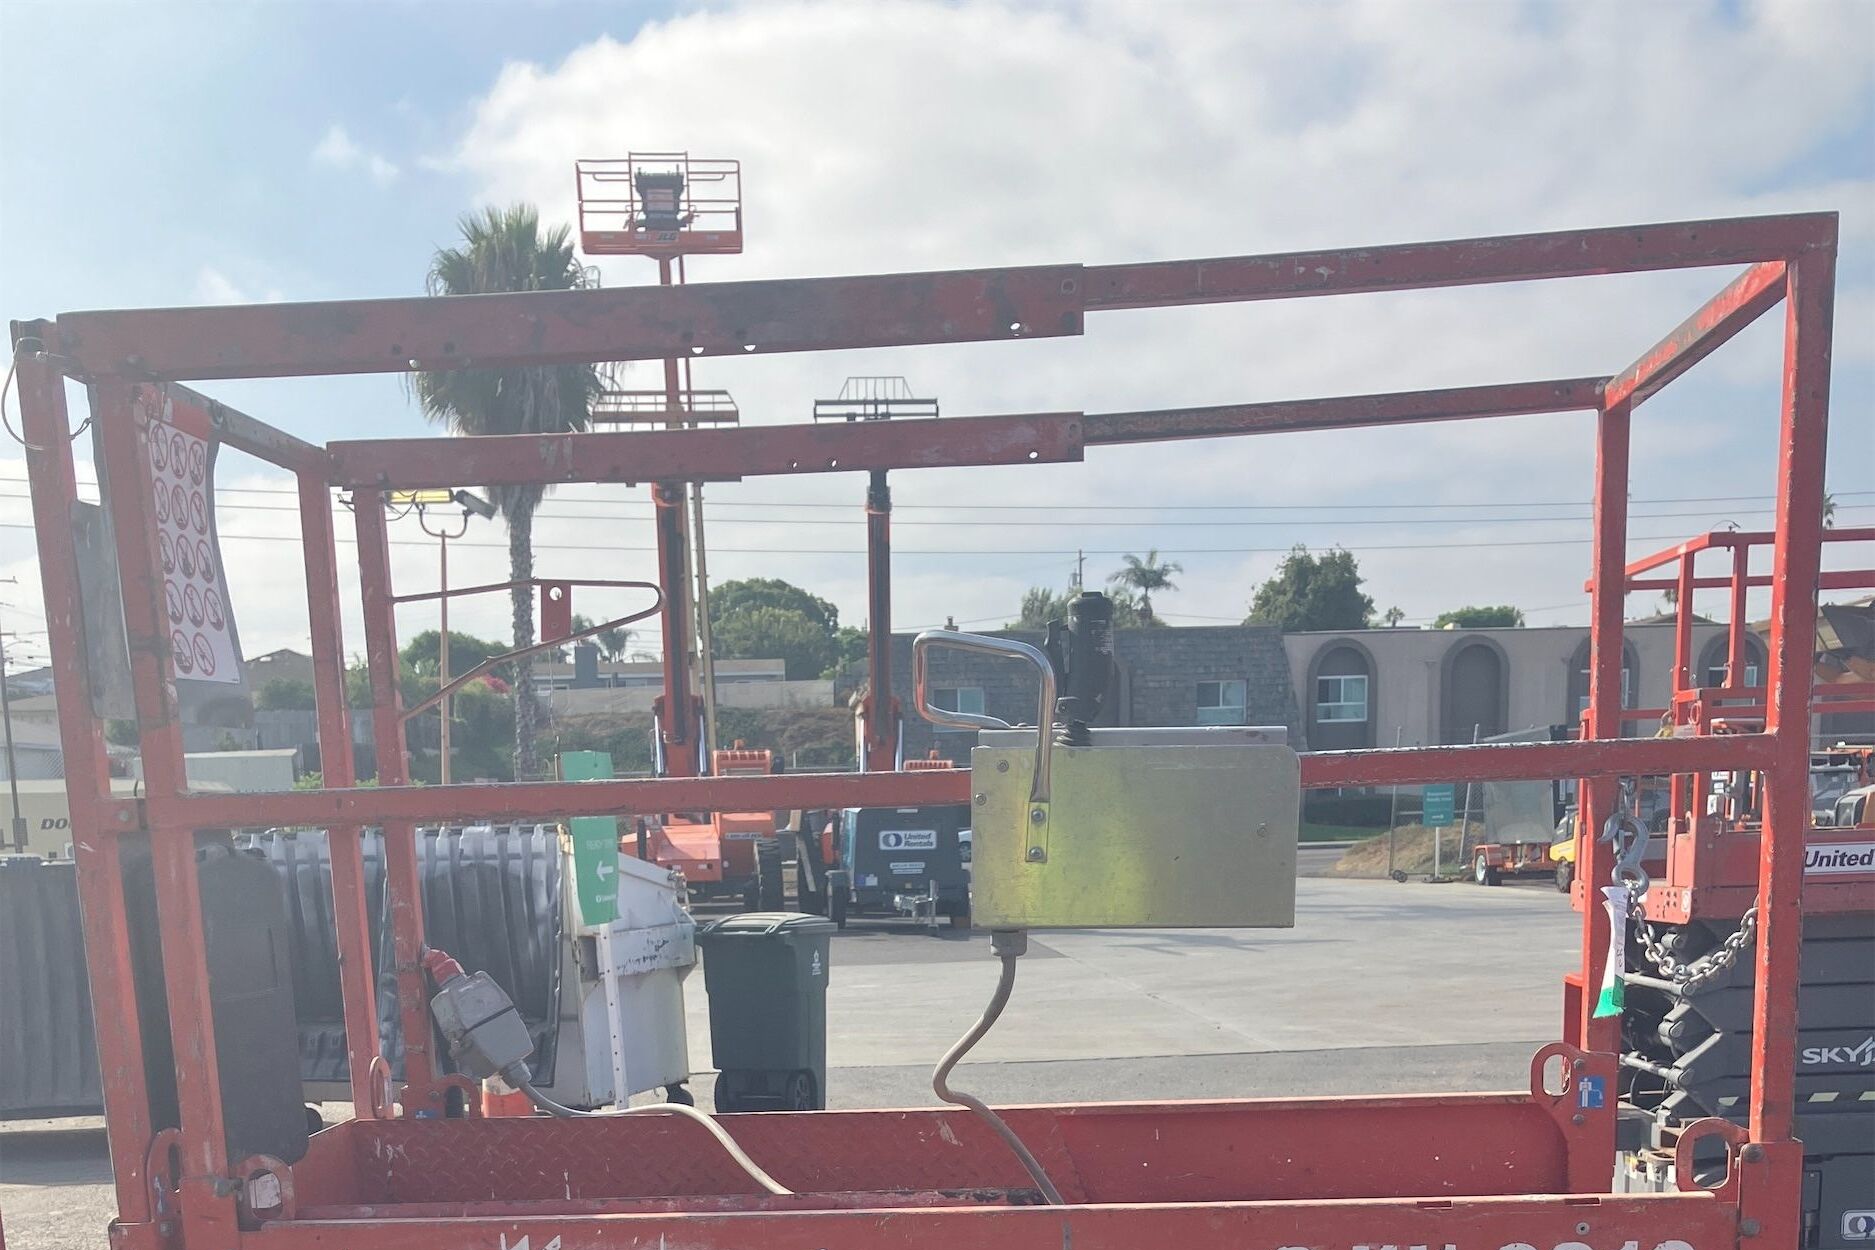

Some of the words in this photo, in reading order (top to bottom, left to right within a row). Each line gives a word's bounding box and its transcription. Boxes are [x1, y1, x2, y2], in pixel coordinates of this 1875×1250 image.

[41, 818, 71, 830] DO
[904, 832, 932, 840] United
[1804, 849, 1875, 868] United
[1802, 1036, 1875, 1066] SKYJ
